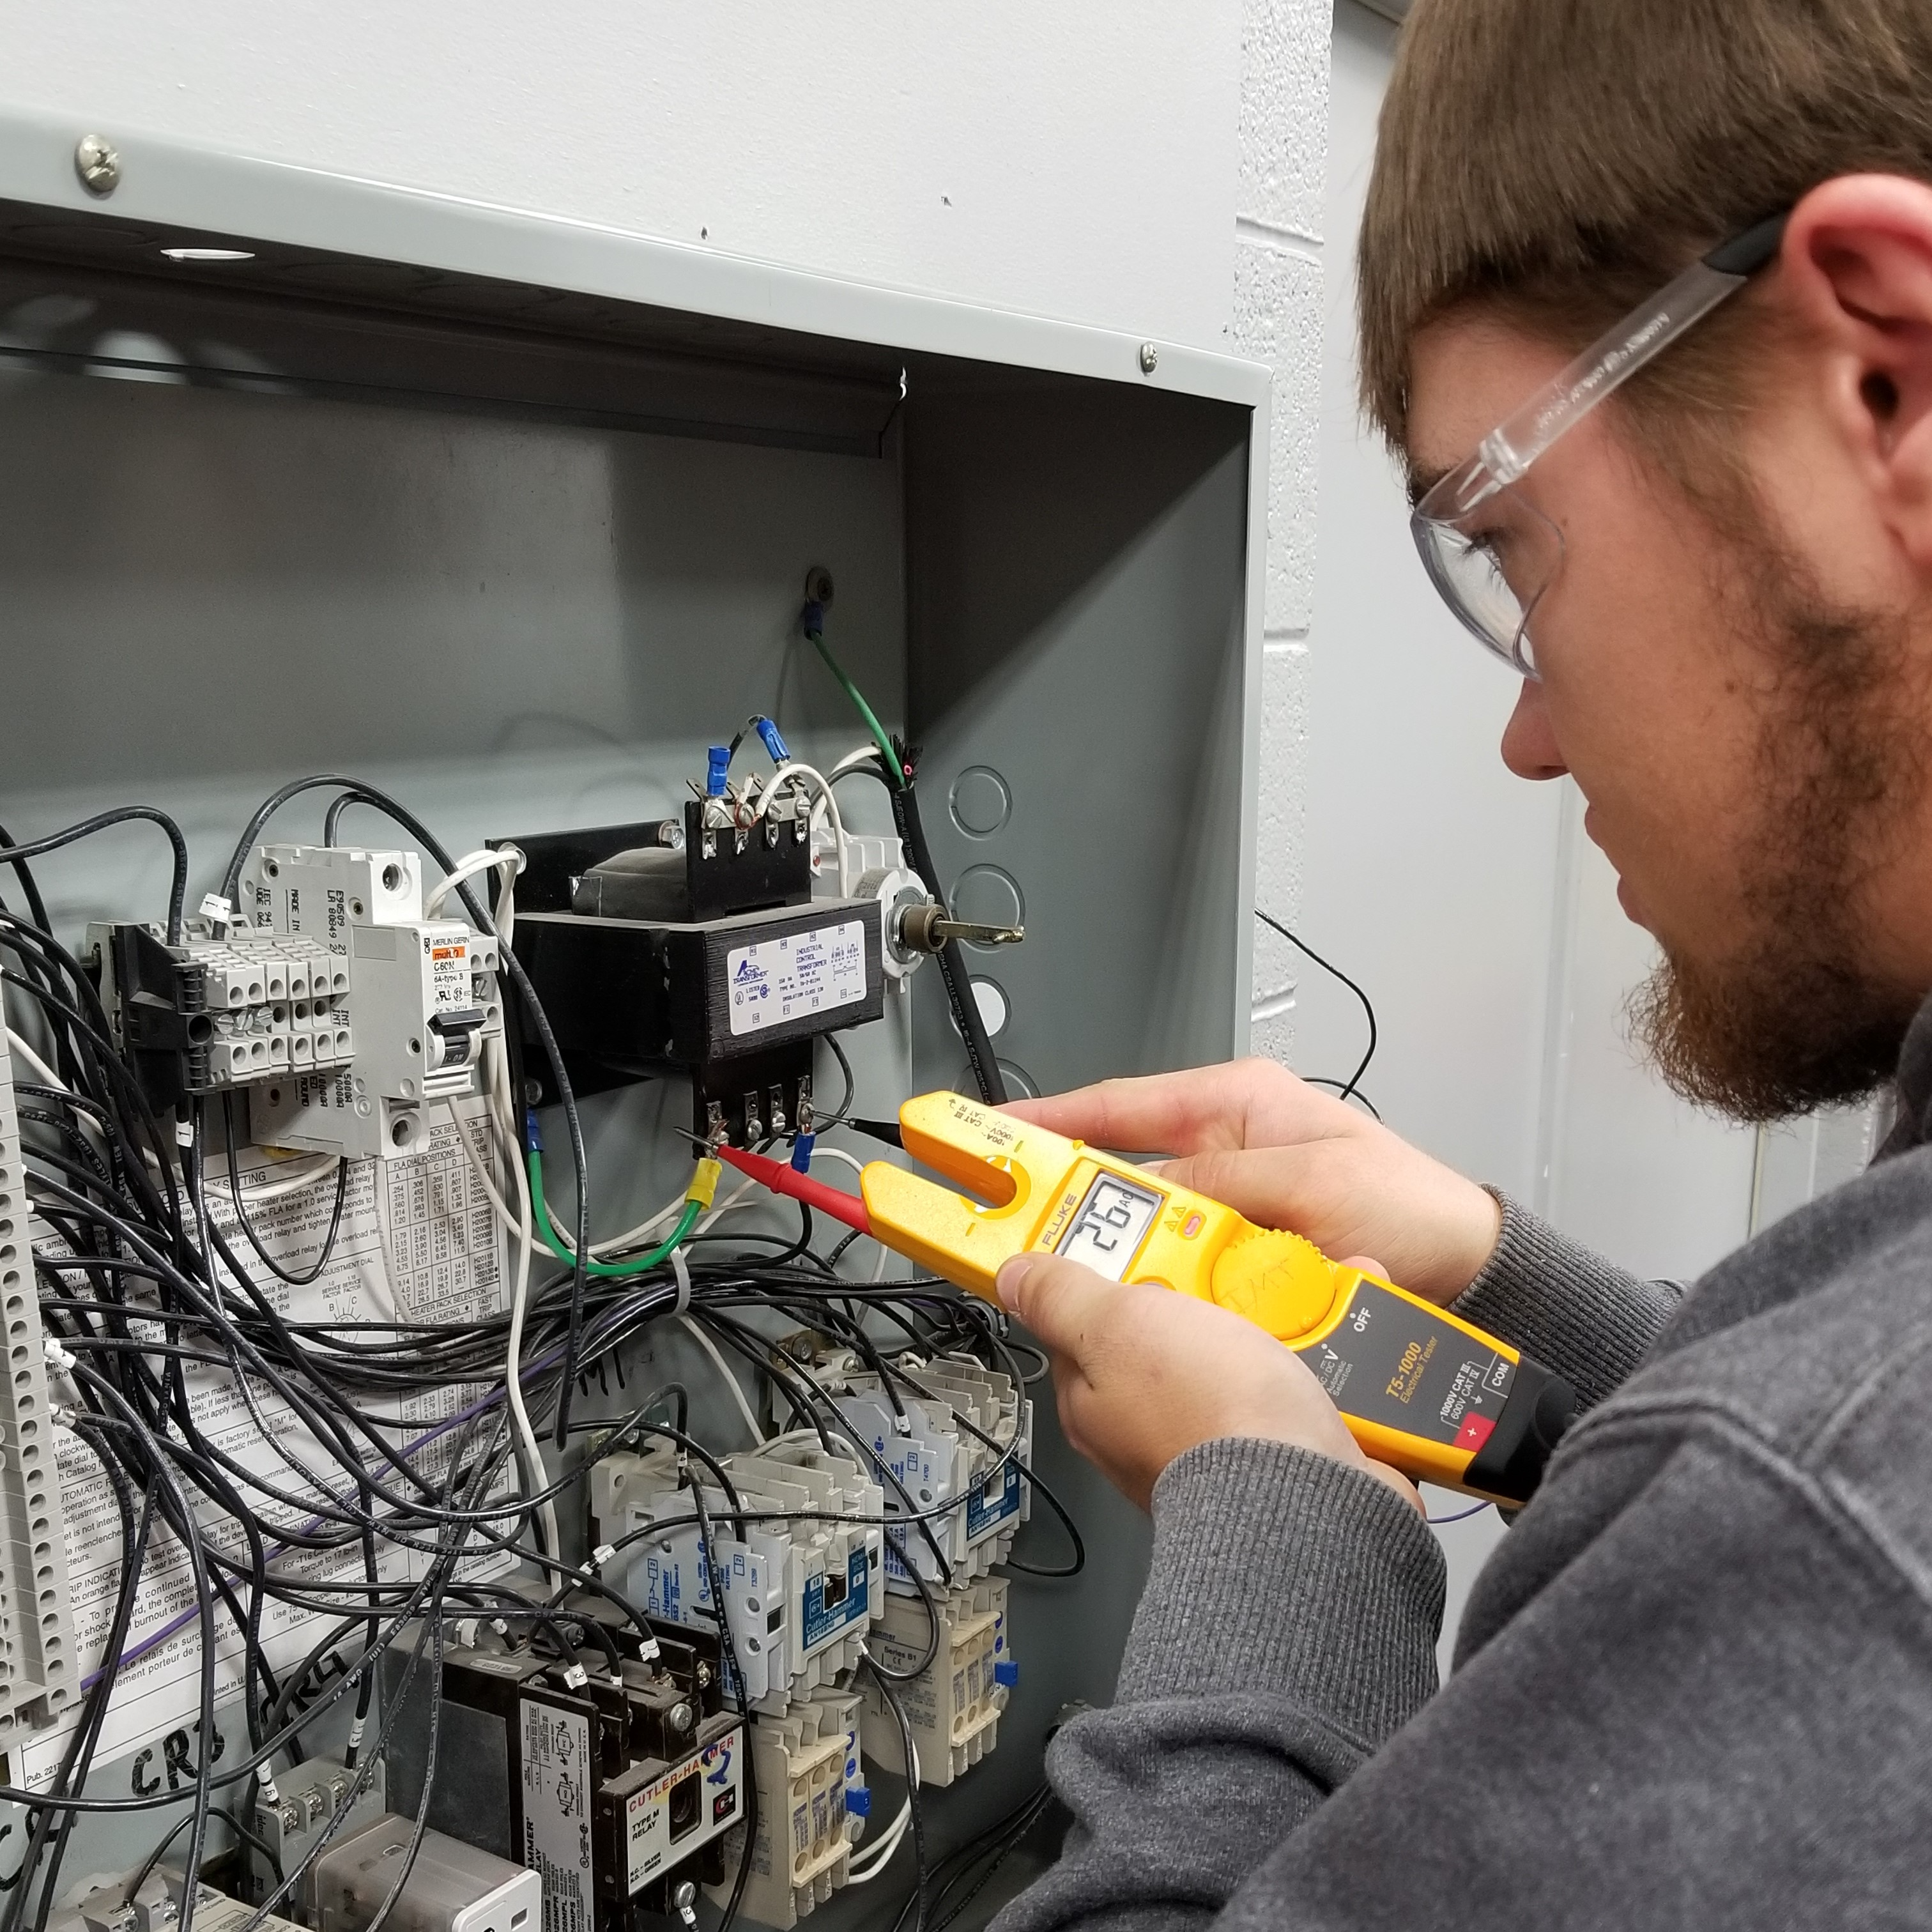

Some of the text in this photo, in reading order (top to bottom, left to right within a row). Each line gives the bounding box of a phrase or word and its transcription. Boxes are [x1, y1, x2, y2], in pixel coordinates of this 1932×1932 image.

[292, 919, 300, 931] IN
[422, 1149, 456, 1163] POSITIONS
[257, 1195, 279, 1208] heater
[286, 1202, 295, 1212] for
[304, 1198, 315, 1208] 1.0
[259, 1209, 323, 1232] pack number which
[1042, 1193, 1077, 1246] FLUKE
[293, 1223, 306, 1233] and
[341, 1230, 368, 1243] overload
[135, 1289, 157, 1301] same
[277, 1283, 289, 1292] the
[277, 1293, 290, 1302] dial
[330, 1296, 357, 1312] B C
[437, 1300, 452, 1309] PACK
[454, 1287, 486, 1303] SELECTION
[279, 1303, 290, 1312] the
[1353, 1307, 1371, 1332] OFF
[1325, 1349, 1339, 1360] V
[56, 1370, 68, 1380] the
[185, 1363, 198, 1372] the
[1325, 1361, 1335, 1374] DC
[1386, 1342, 1422, 1397] T5-1000
[1492, 1363, 1509, 1386] COM
[1326, 1360, 1347, 1394] Automatic
[1333, 1363, 1353, 1397] Selection
[1400, 1362, 1424, 1404] Electrical
[192, 1384, 233, 1403] been made,
[215, 1395, 229, 1406] less
[1440, 1390, 1457, 1416] 1000V
[1452, 1372, 1466, 1391] CAT
[1451, 1397, 1466, 1420] 600V
[1461, 1378, 1475, 1397] CAT
[198, 1406, 230, 1422] not apply
[58, 1438, 70, 1448] the
[226, 1429, 250, 1445] factory
[74, 1453, 88, 1464] dial
[66, 1462, 97, 1478] Catalog
[99, 1491, 108, 1500] as
[64, 1504, 106, 1526] adjustment
[82, 1523, 95, 1535] not
[220, 1524, 229, 1535] for
[219, 1535, 230, 1545] the
[151, 1549, 165, 1560] test
[282, 1561, 295, 1570] For
[300, 1551, 342, 1574] Torque to 17
[323, 1568, 334, 1577] lug
[83, 1584, 109, 1600] orange
[145, 1572, 190, 1598] continued
[84, 1597, 162, 1637] shock the
[89, 1611, 100, 1621] To
[134, 1597, 194, 1629] burnout of the
[272, 1608, 287, 1619] Use
[289, 1614, 306, 1624] Max.
[125, 1641, 178, 1671] Le relais de
[148, 1646, 194, 1675] porteur de
[26, 1772, 43, 1784] Pub.
[629, 1736, 734, 1813] CUTLER-HAMER
[257, 1814, 266, 1836] idec
[631, 1808, 659, 1832] TYPE M
[632, 1820, 657, 1841] RELAY
